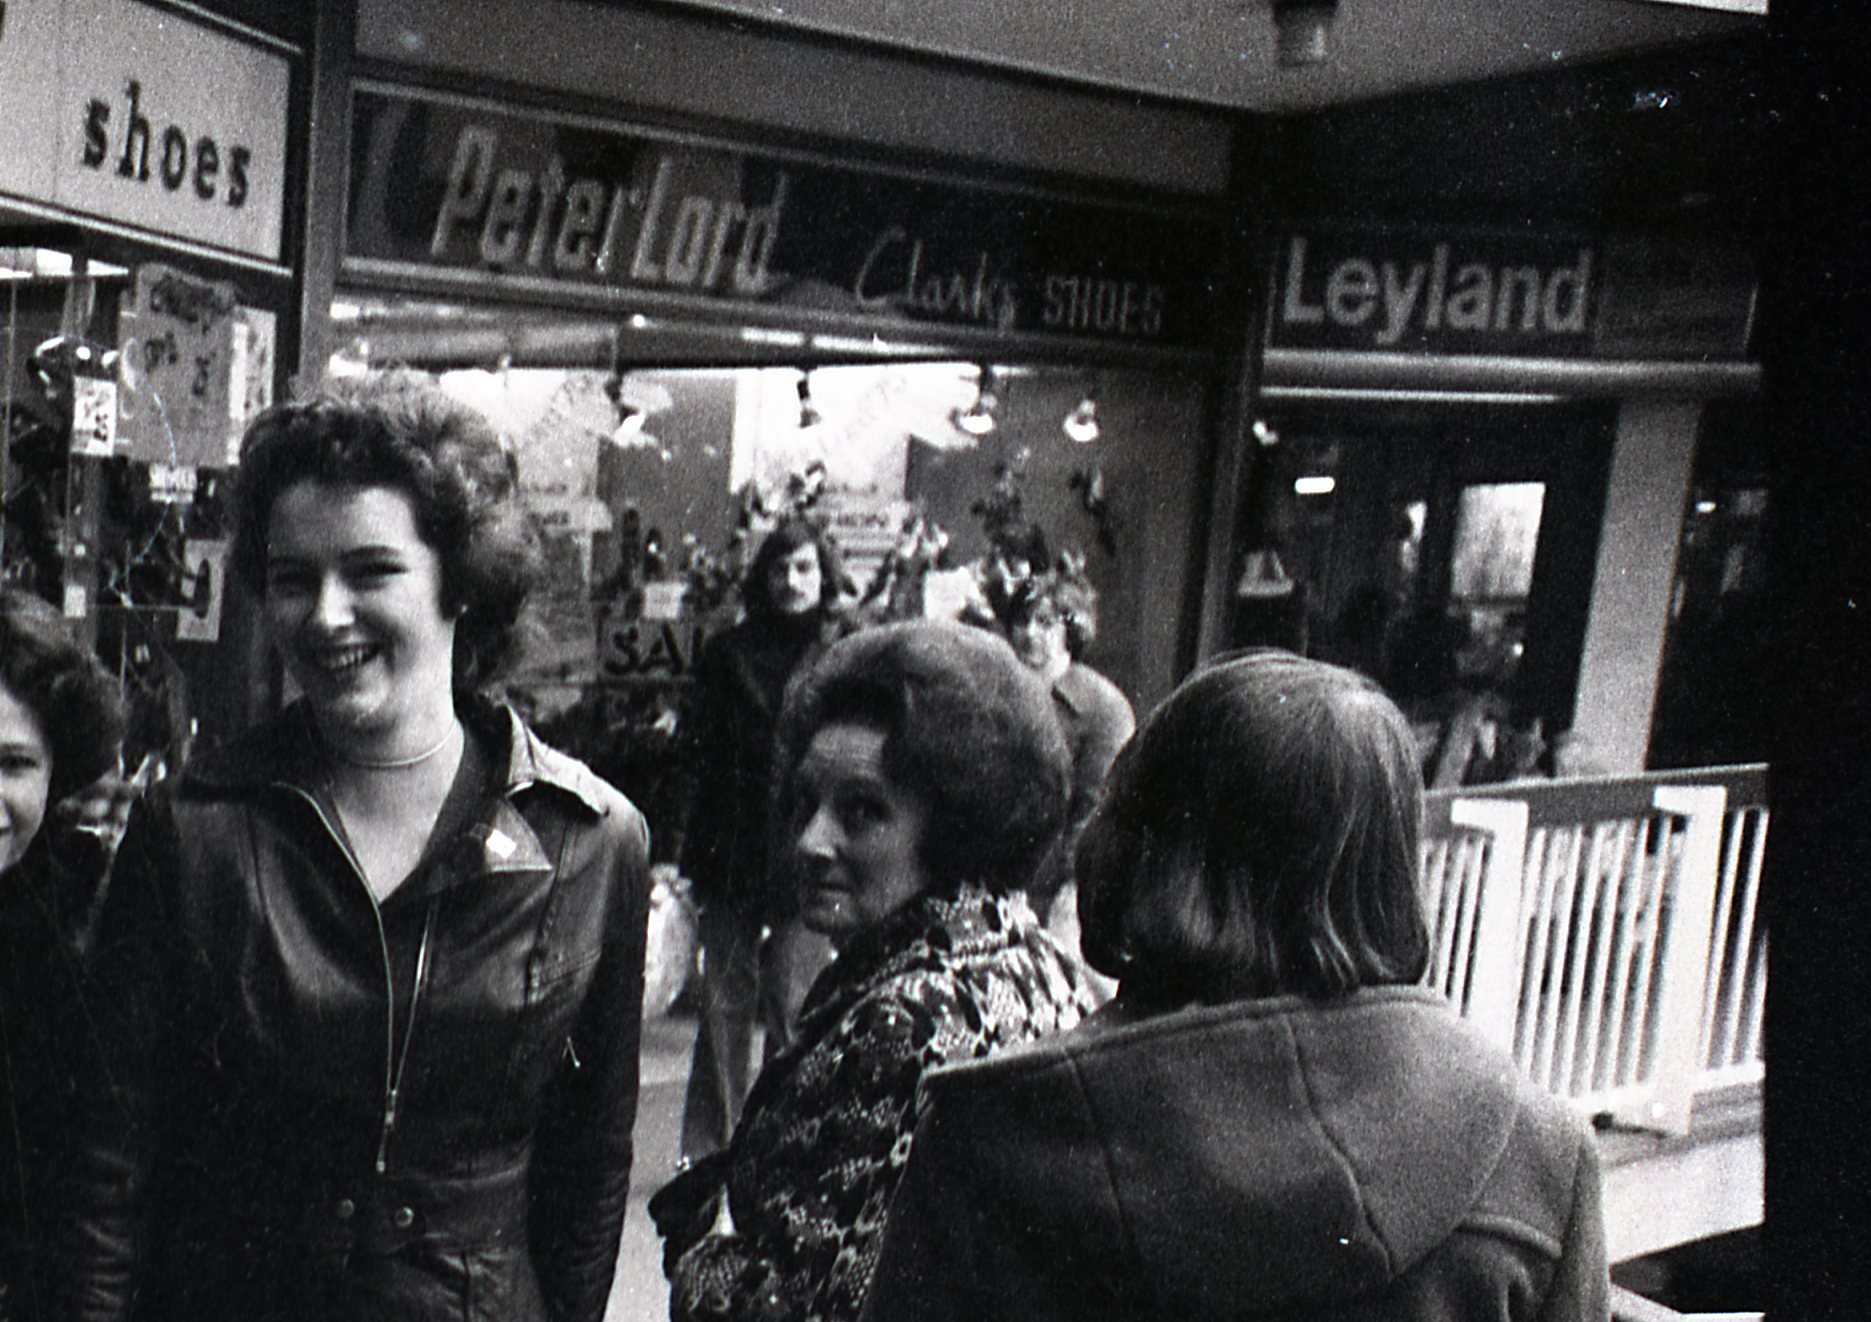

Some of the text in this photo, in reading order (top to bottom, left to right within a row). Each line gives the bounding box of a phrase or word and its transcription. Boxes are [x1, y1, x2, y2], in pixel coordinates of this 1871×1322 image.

[81, 79, 251, 209] shoes
[1043, 275, 1164, 332] SHOES
[1284, 238, 1593, 344] Leyland
